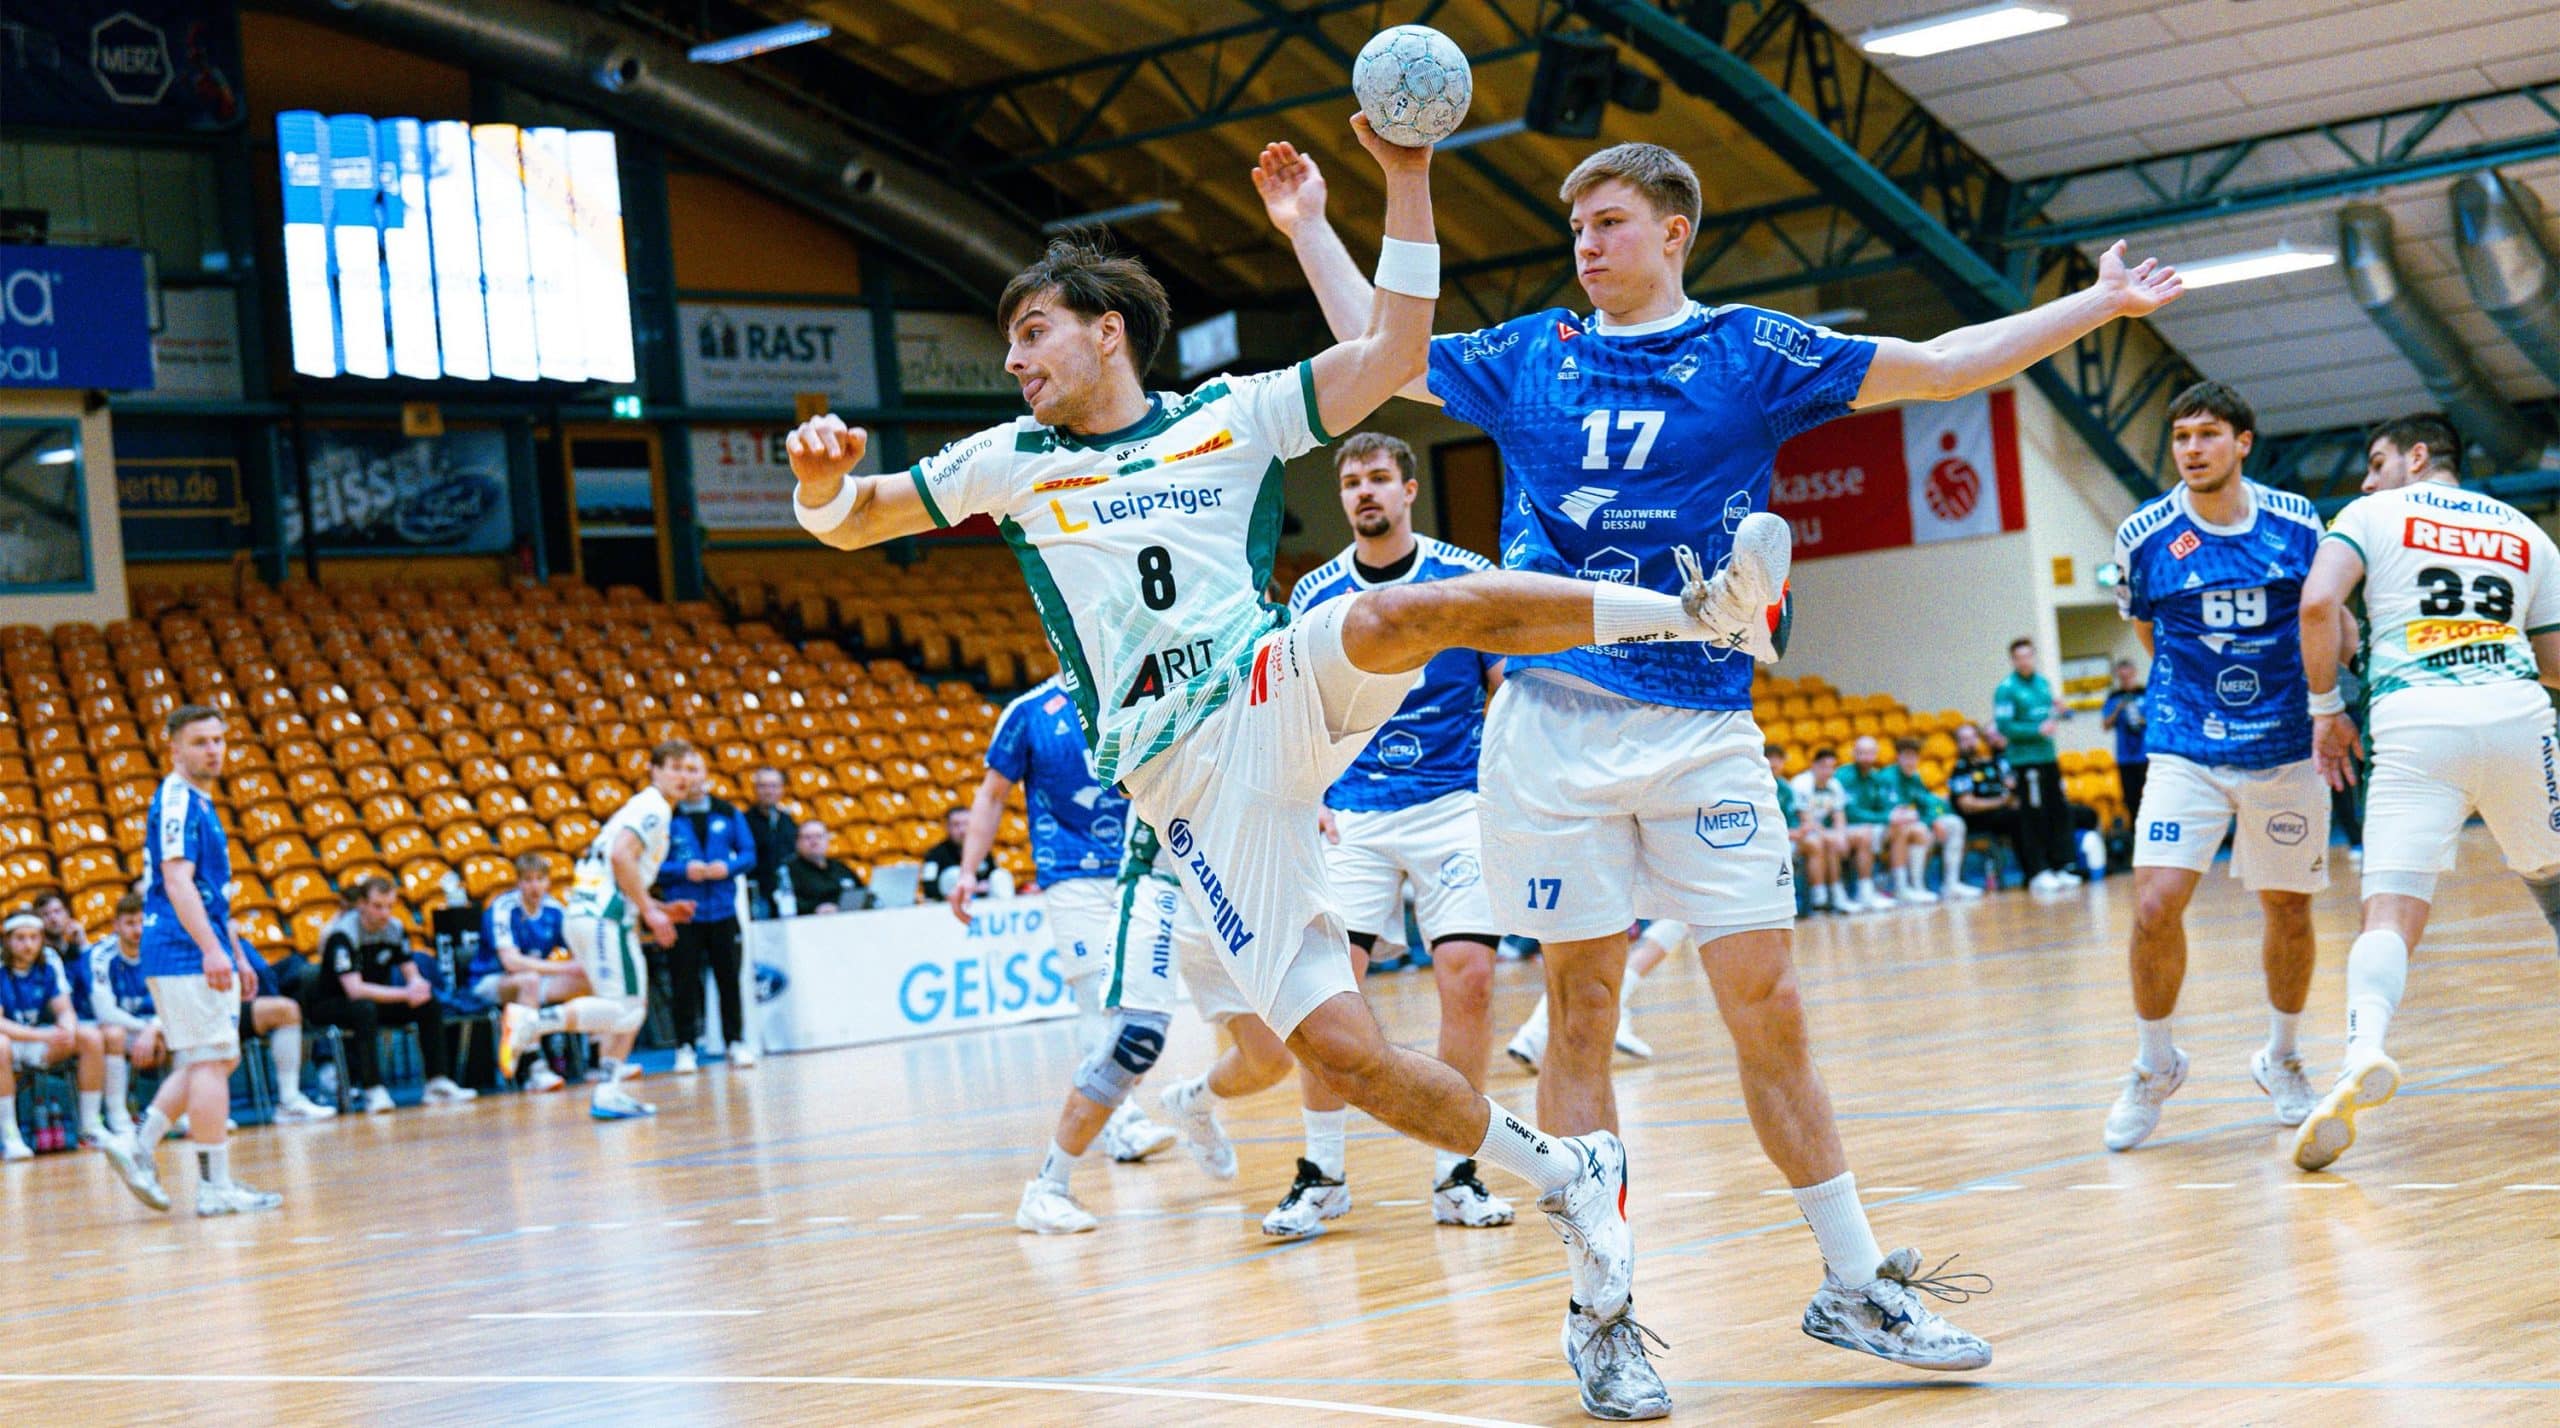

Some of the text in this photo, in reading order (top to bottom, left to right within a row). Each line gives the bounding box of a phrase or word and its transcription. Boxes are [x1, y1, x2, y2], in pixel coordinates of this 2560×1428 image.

[103, 46, 161, 75] MERZ
[746, 324, 837, 362] RAST
[1755, 315, 1812, 361] IHM
[1557, 371, 1580, 381] SELECT
[1175, 434, 1229, 460] DHL
[1580, 409, 1666, 470] 17
[1042, 474, 1099, 491] DHL
[1092, 484, 1223, 525] Leipziger
[1602, 508, 1678, 520] STADTWERKE
[1602, 519, 1647, 531] DESSAU
[2173, 533, 2198, 557] DB
[2412, 519, 2525, 566] REWE
[1137, 545, 1177, 611] 8
[2202, 587, 2268, 628] 69
[2417, 567, 2514, 624] 33
[1618, 632, 1659, 645] CRAFT
[1120, 638, 1214, 709] ARLT
[2221, 679, 2256, 693] MERZ
[1703, 810, 1751, 832] MERZ
[2149, 821, 2181, 842] 69
[2272, 821, 2303, 834] MERZ
[1190, 851, 1255, 957] Allianz
[1527, 877, 1562, 910] 17
[967, 909, 1043, 937] AUTO
[1073, 940, 1087, 957] 6
[1505, 1116, 1537, 1144] CRAFT
